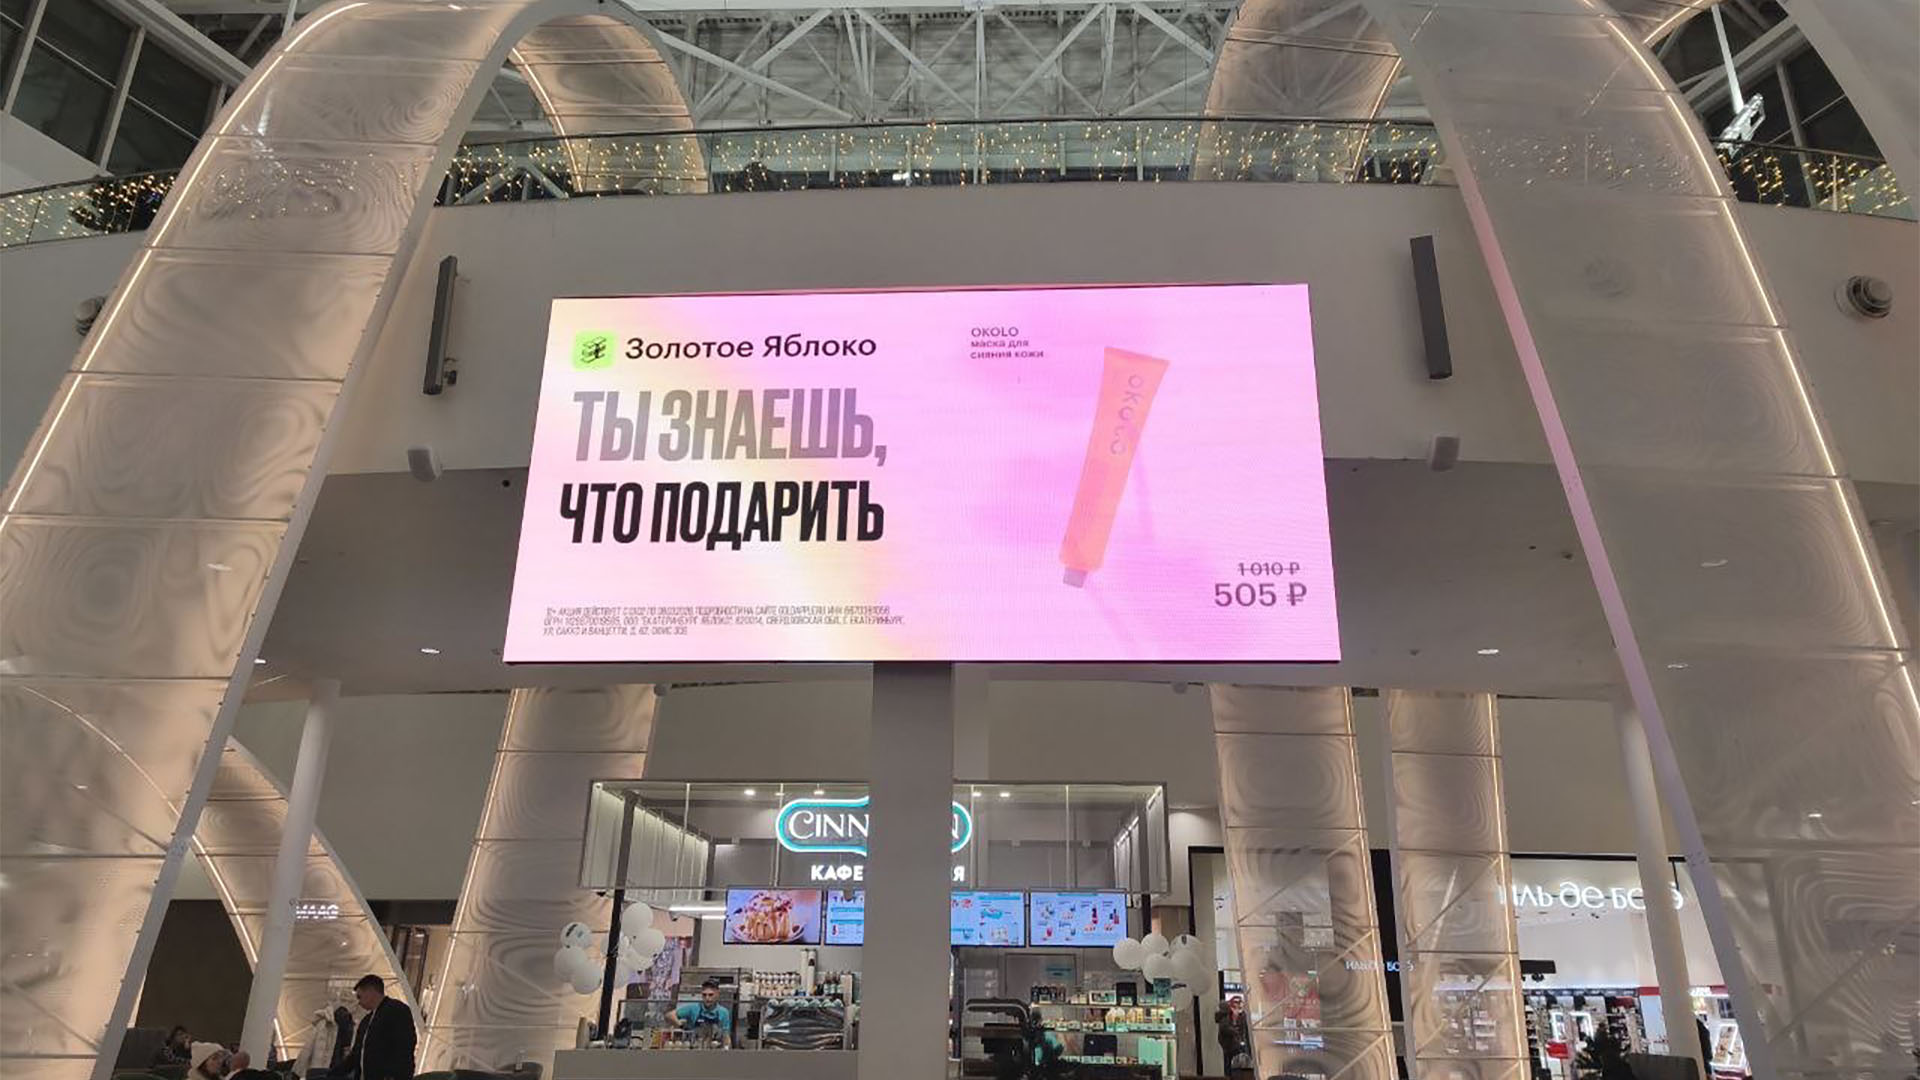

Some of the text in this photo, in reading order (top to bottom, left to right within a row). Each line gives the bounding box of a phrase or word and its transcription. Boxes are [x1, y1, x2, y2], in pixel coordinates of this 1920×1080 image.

[970, 340, 1029, 349] маска для
[971, 326, 1019, 338] OKOLO
[625, 333, 877, 360] Золотое Яблоко
[970, 350, 1044, 359] сияния кожи
[573, 387, 888, 468] ТЫ ЗНАЕШЬ,
[559, 480, 885, 551] ЧТО ПОДАРИТЬ
[1214, 582, 1278, 607] 505
